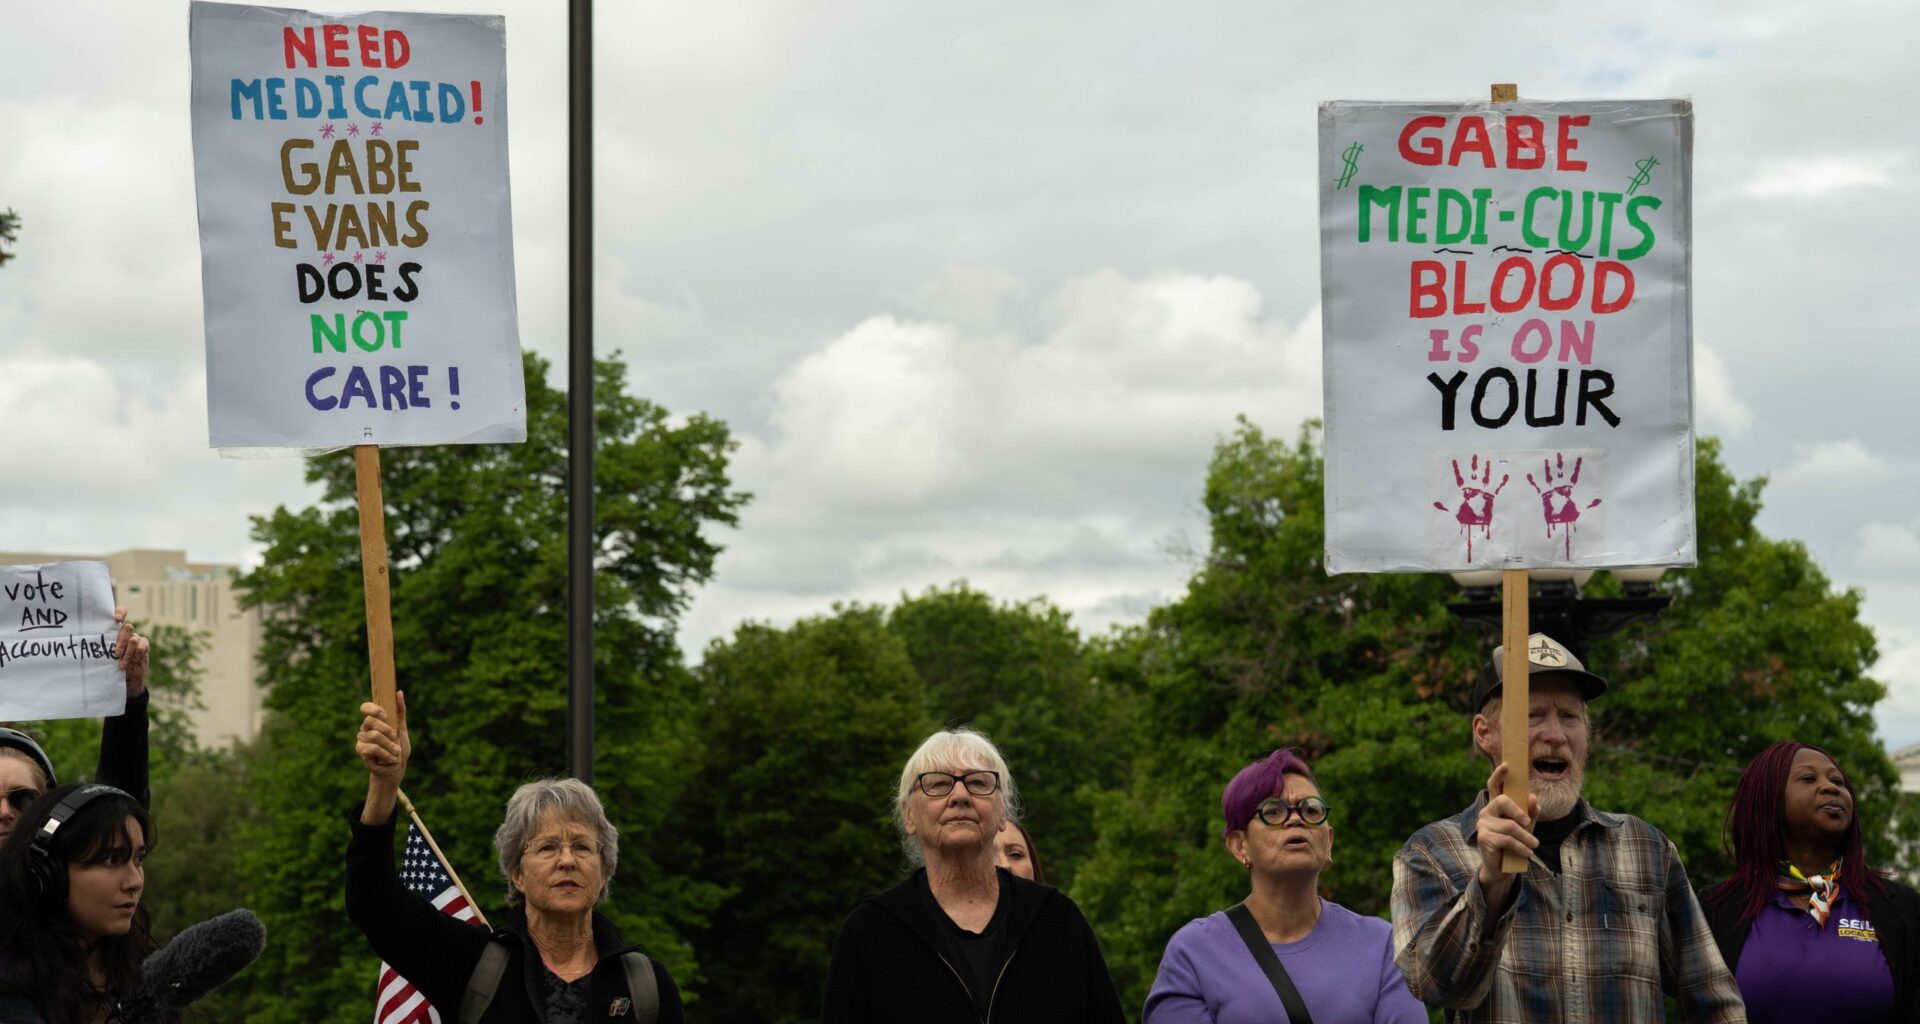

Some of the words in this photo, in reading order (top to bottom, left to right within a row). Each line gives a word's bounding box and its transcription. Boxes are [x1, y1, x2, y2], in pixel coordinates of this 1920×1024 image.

[283, 25, 411, 69] NEED
[231, 75, 484, 125] MEDICAID!
[280, 138, 422, 196] GABE
[1398, 115, 1591, 172] GABE
[271, 200, 430, 251] EVANS
[1357, 184, 1662, 261] MEDI-CUTS
[296, 261, 423, 304] DOES
[1409, 252, 1636, 319] BLOOD
[310, 310, 409, 354] NOT
[1427, 324, 1484, 363] IS
[1510, 318, 1596, 366] ON
[1426, 366, 1622, 431] YOUR
[4, 570, 64, 604] vote
[21, 606, 68, 627] AND
